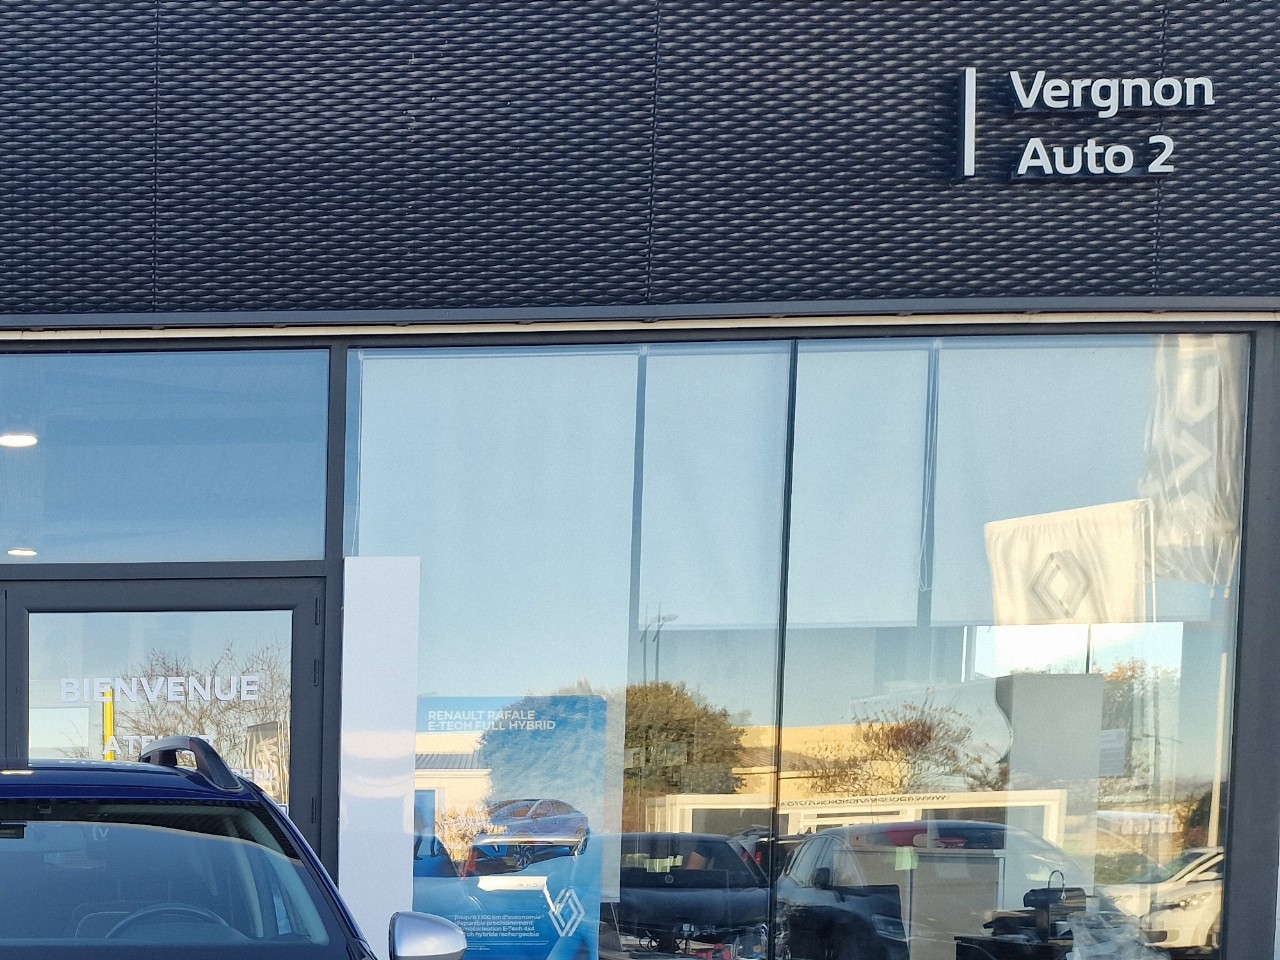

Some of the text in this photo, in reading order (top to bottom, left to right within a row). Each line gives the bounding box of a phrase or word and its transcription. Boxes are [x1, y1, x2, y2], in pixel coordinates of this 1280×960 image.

[1010, 70, 1216, 118] Vergnon
[1017, 135, 1175, 174] Auto 2
[60, 676, 260, 703] BIENVENUE
[428, 710, 536, 721] RENAULT RAFALE
[428, 720, 556, 731] E-TECH FULL HYBRID
